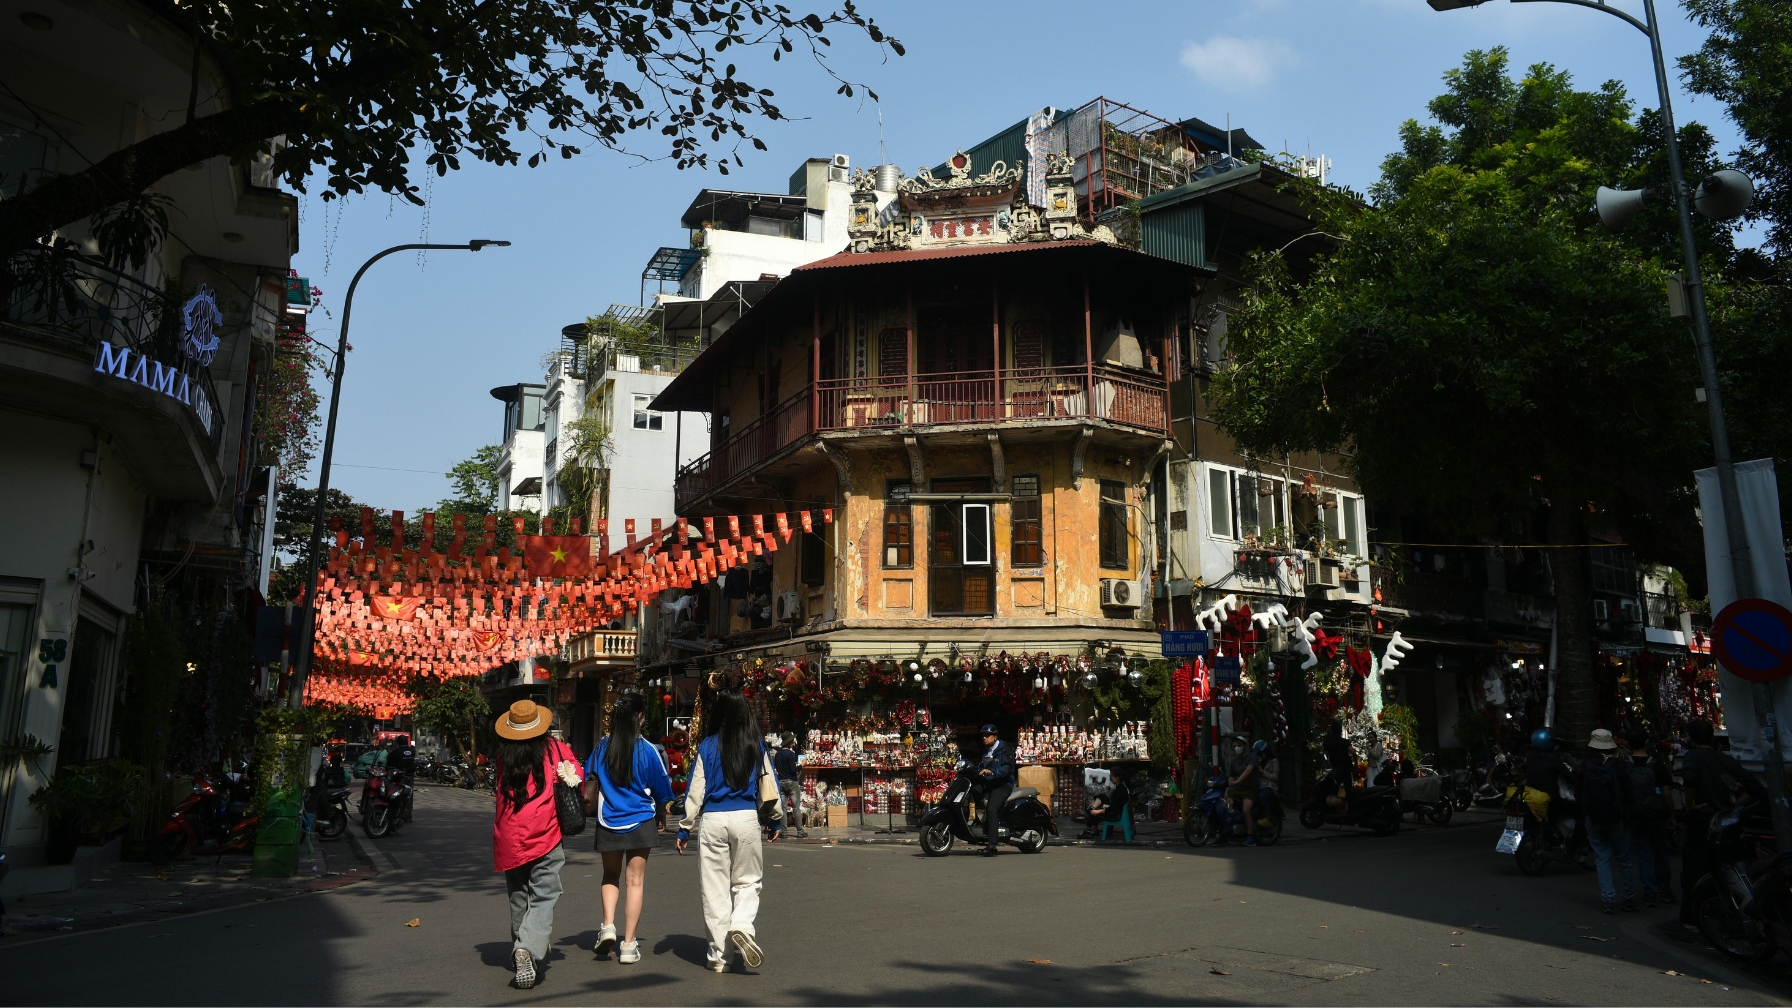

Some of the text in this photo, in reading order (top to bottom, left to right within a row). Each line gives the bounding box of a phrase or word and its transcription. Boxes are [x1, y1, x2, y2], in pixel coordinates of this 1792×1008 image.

[95, 340, 191, 406] MAMA
[39, 639, 67, 662] 58
[1165, 641, 1185, 652] HÀNG
[39, 664, 58, 688] A
